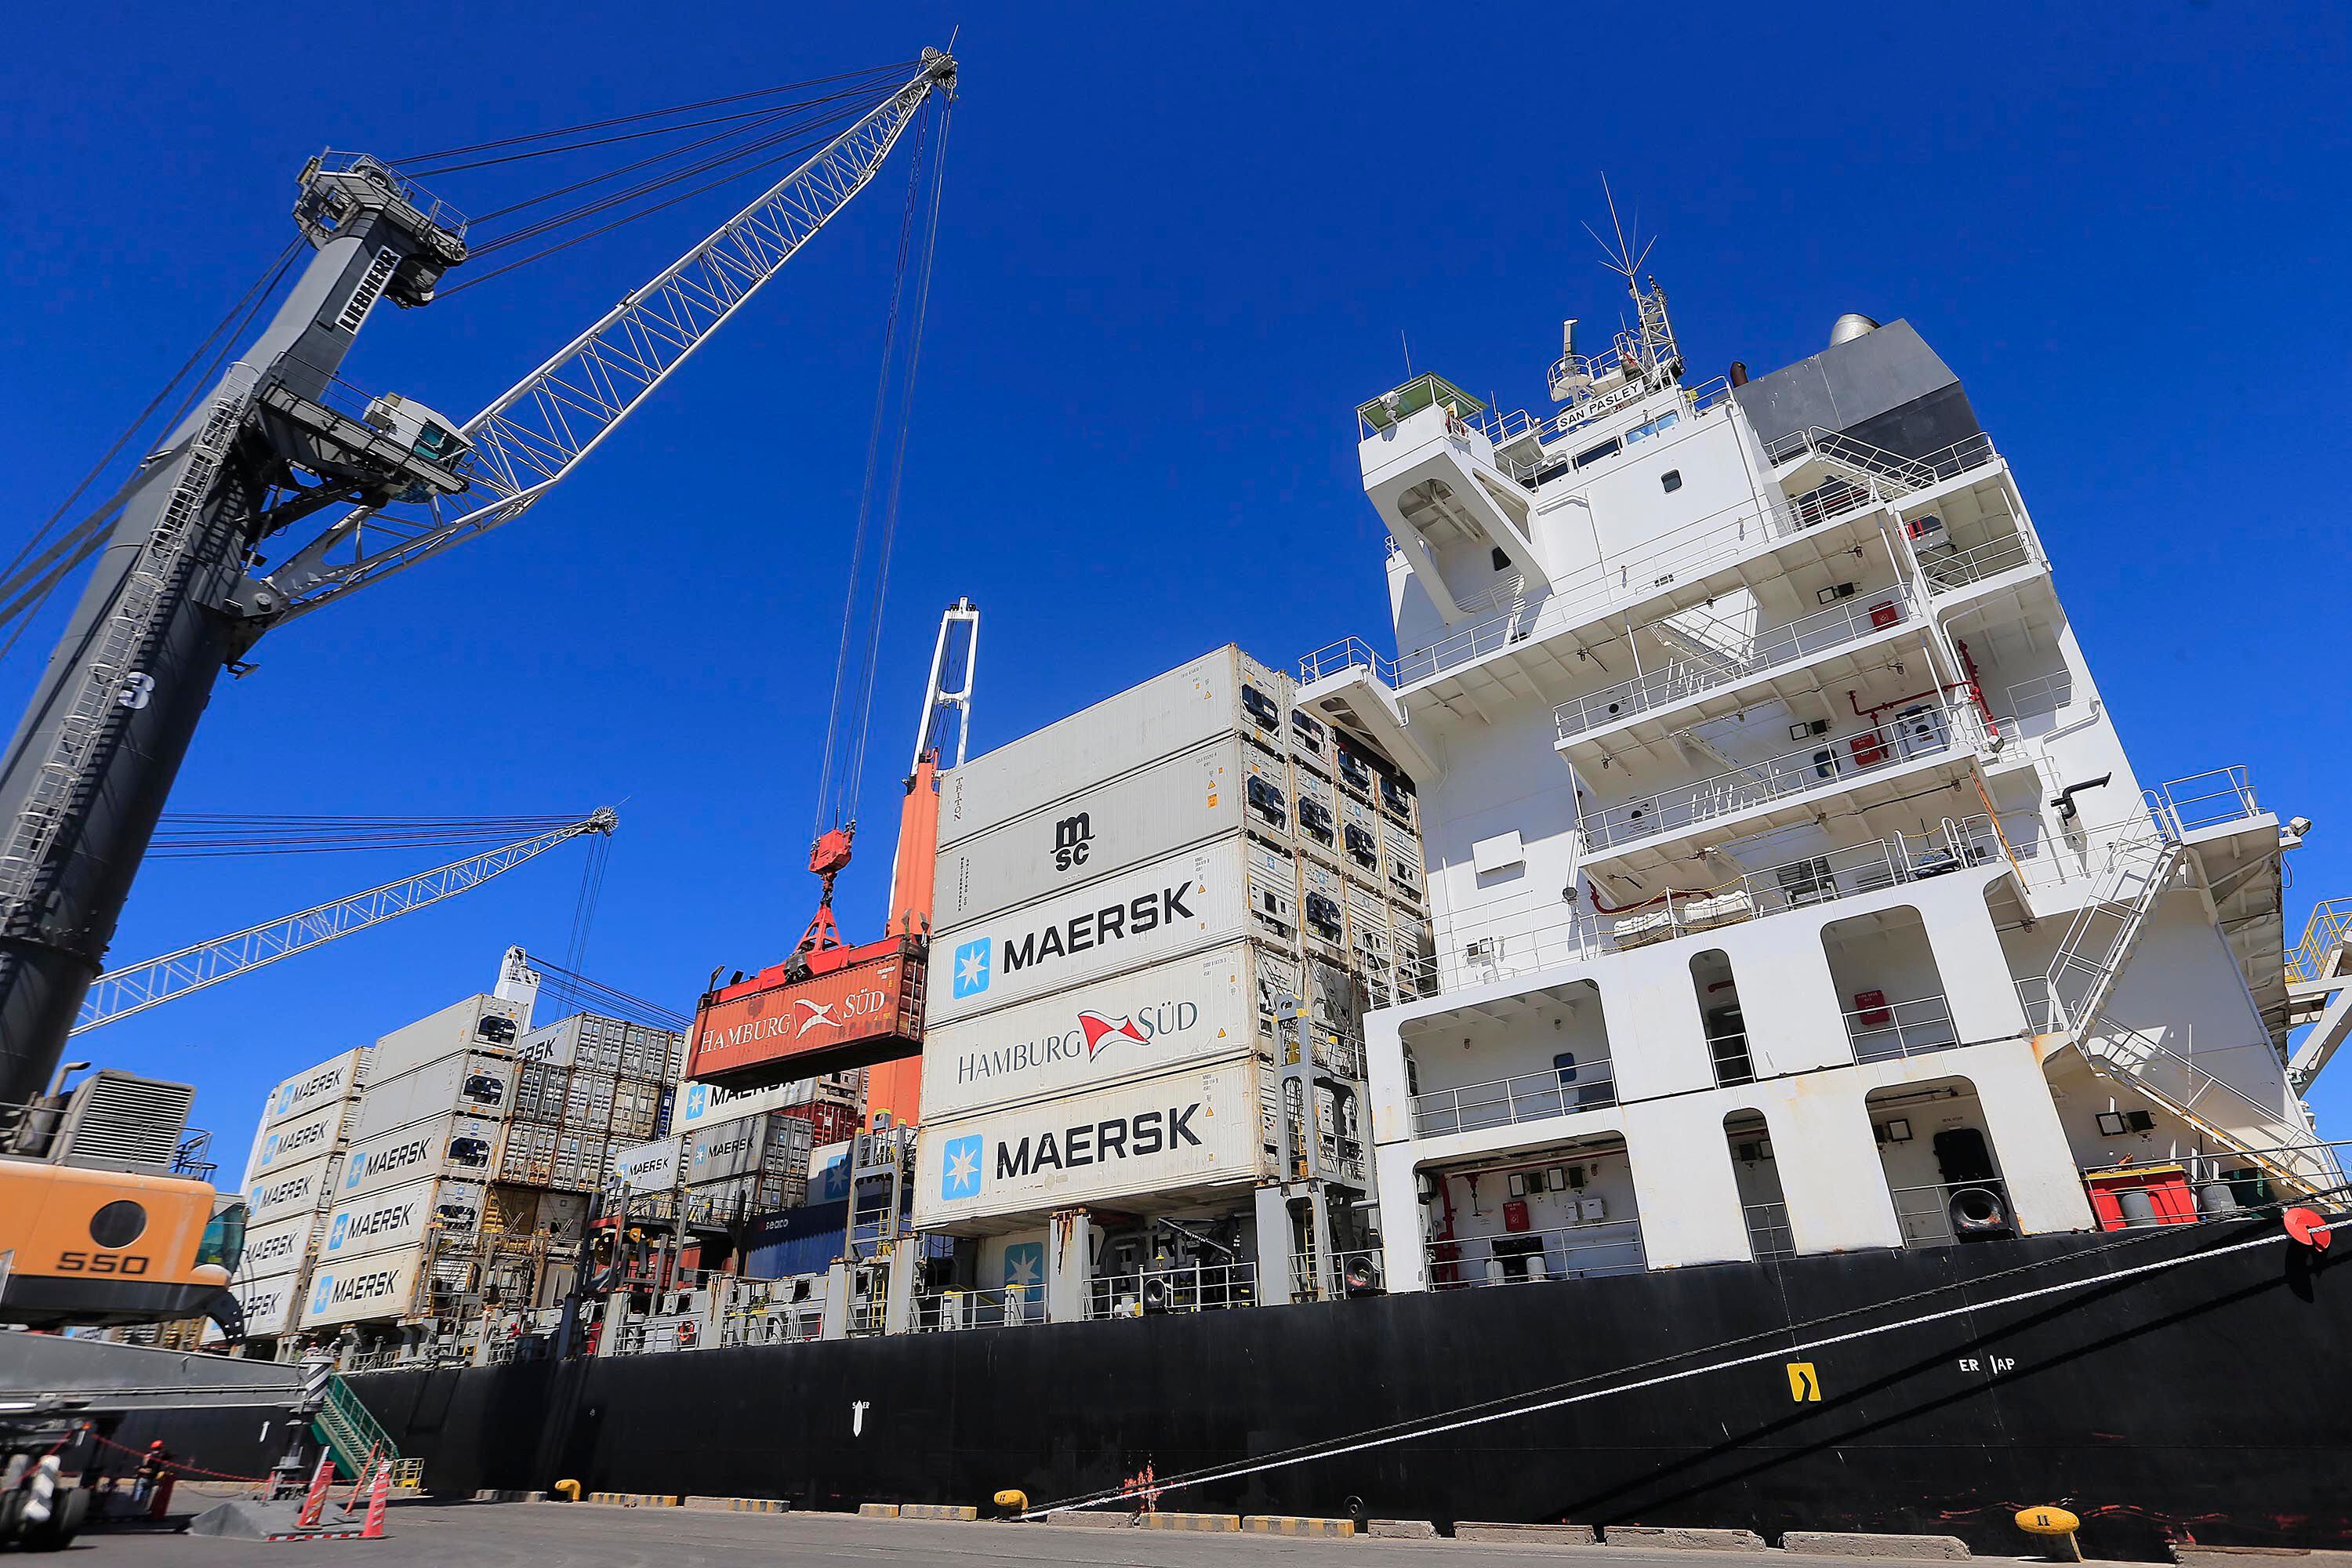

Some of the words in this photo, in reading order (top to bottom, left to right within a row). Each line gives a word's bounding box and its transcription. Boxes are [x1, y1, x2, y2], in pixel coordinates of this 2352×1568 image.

[339, 249, 399, 332] LIEBHERR
[1559, 409, 1584, 427] SAN
[1589, 383, 1639, 414] PASLEY
[118, 671, 155, 710] 3
[953, 776, 964, 822] TRITON
[1004, 880, 1195, 975] MAERSK
[699, 1013, 791, 1054] HAMBURG
[843, 989, 885, 1018] SÜD
[959, 1030, 1080, 1084] HAMBURG
[1137, 1001, 1198, 1040] SÜD
[292, 1067, 345, 1104] MAERSK
[276, 1120, 329, 1155] MAERSK
[708, 1137, 755, 1158] MAERSK
[996, 1103, 1203, 1180] MAERSK
[365, 1138, 431, 1177] MAERSK
[630, 1156, 669, 1177] MAERSK
[260, 1174, 314, 1209] MAERSK
[347, 1203, 414, 1240] MAERSK
[765, 1218, 789, 1231] seaco
[56, 1252, 150, 1275] 550
[332, 1269, 399, 1304] MAERSK
[1958, 1359, 1980, 1372] ER
[1997, 1358, 2016, 1370] AP
[2037, 1515, 2051, 1526] 11
